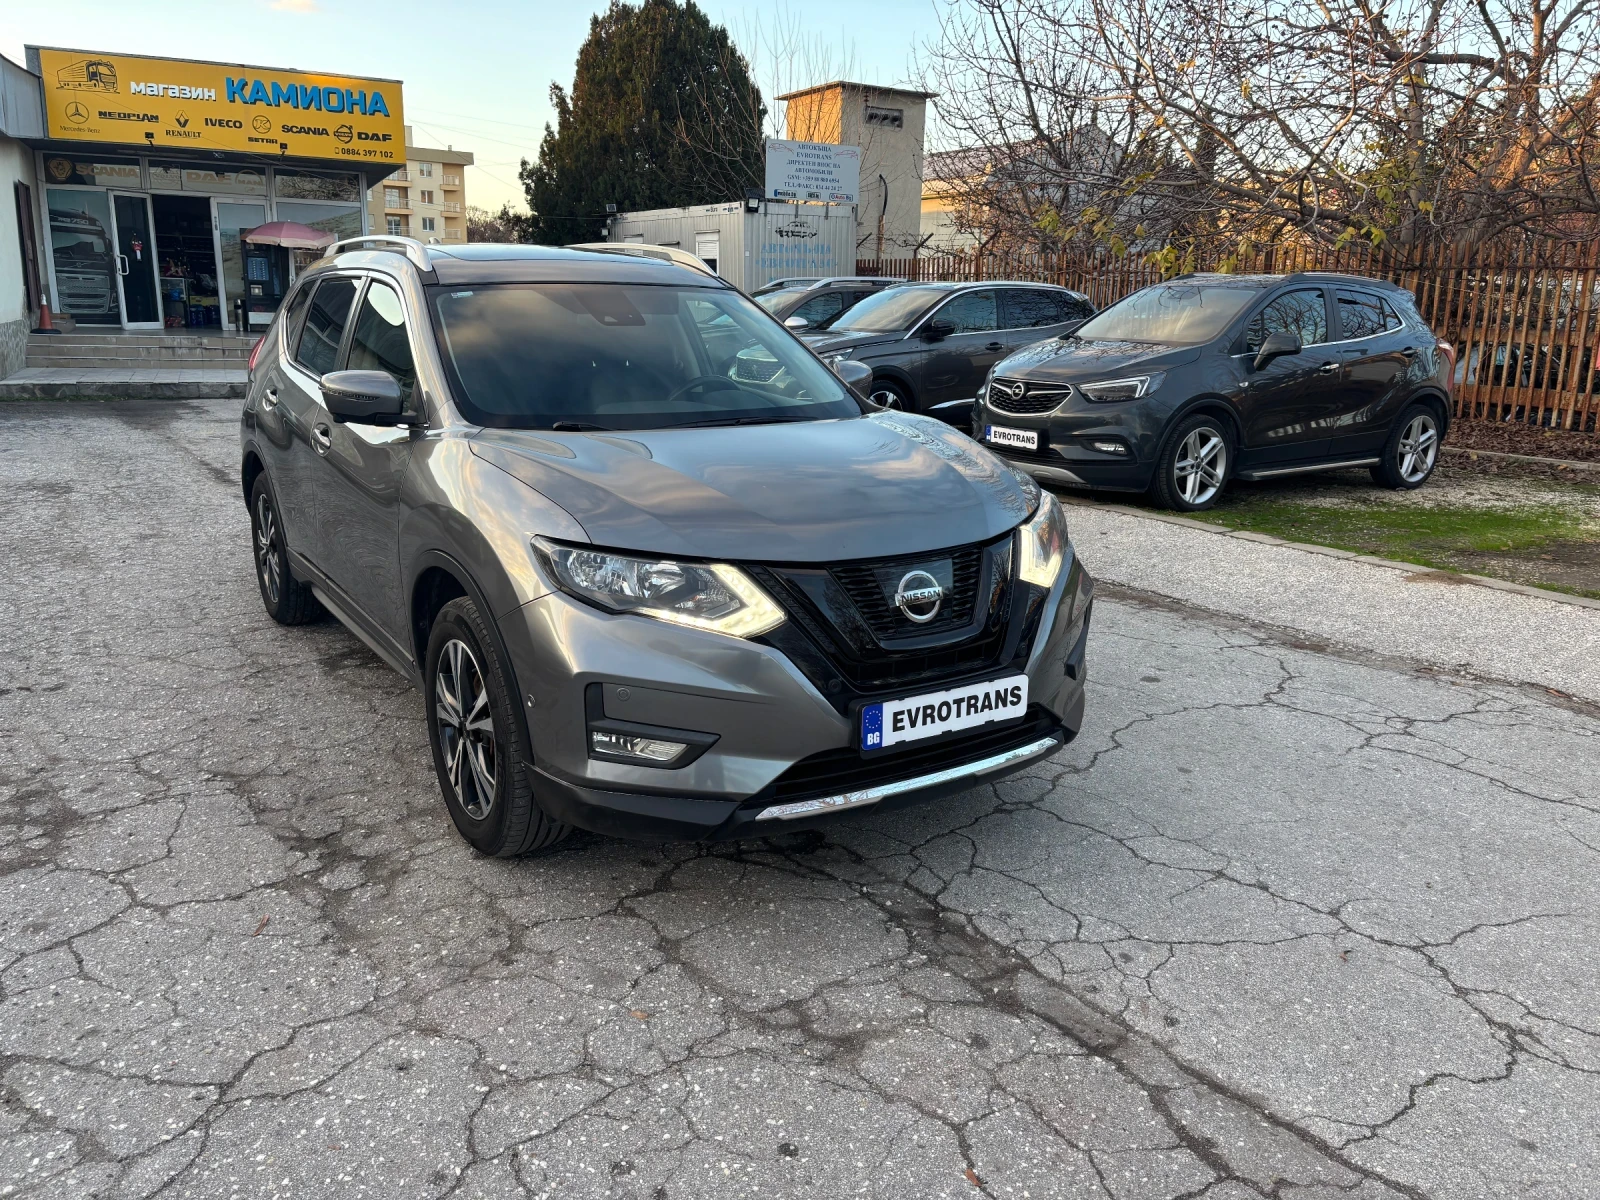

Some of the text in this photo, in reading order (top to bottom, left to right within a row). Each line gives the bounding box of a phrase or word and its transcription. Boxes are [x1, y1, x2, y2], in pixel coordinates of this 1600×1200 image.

[130, 77, 389, 117] магазин КАМИОНА
[98, 110, 159, 122] NEOPLAN
[204, 117, 243, 129] IVECO
[166, 129, 202, 139] RENAULT
[281, 124, 330, 136] SCANIA
[247, 137, 278, 145] SETRA
[357, 131, 392, 142] DAF
[341, 148, 394, 158] 0884 397 102
[796, 152, 832, 160] EVROTRANS
[75, 164, 139, 178] SCANIA
[186, 171, 232, 183] DAF
[993, 430, 1035, 445] EVROTRANS
[901, 589, 940, 603] NISSAN
[892, 685, 1022, 732] EVROTRANS
[867, 731, 880, 746] BG
